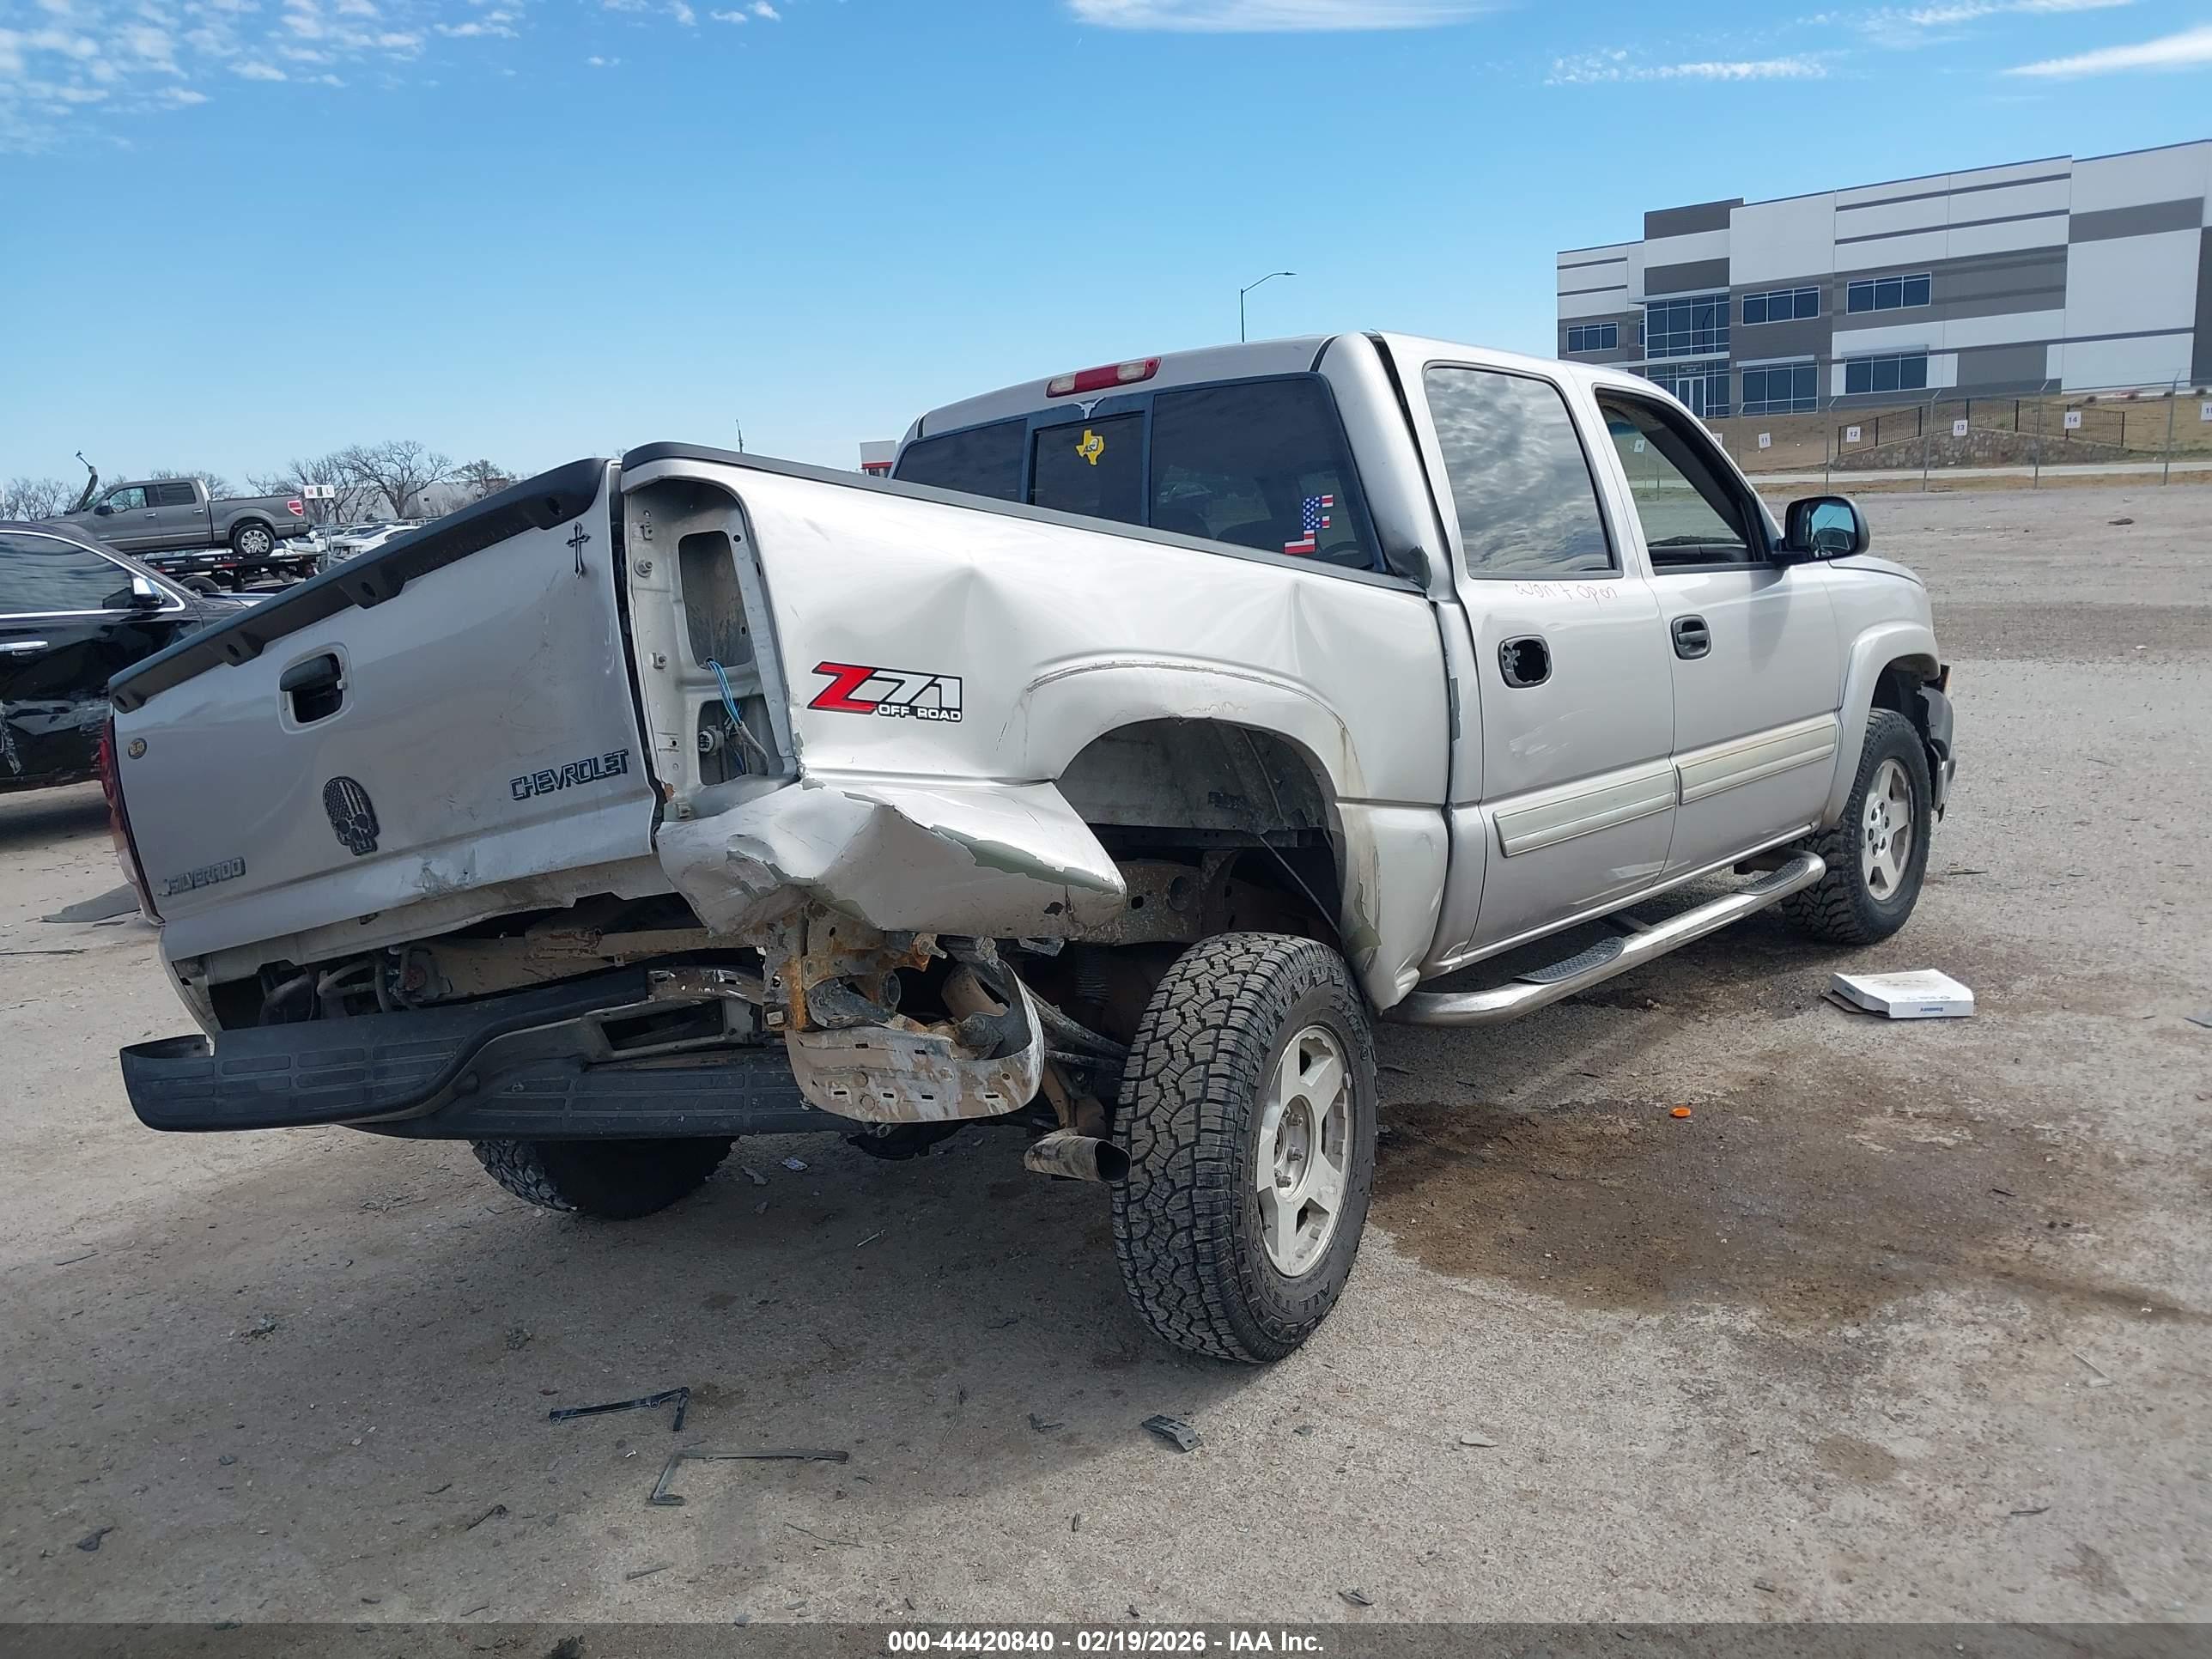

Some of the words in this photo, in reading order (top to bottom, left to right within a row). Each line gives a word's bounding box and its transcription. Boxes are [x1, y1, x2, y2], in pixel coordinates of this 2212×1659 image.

[806, 661, 963, 715] Z71
[878, 704, 910, 717] OFF
[916, 708, 963, 722] ROAD
[509, 748, 629, 801] CHEVROLET
